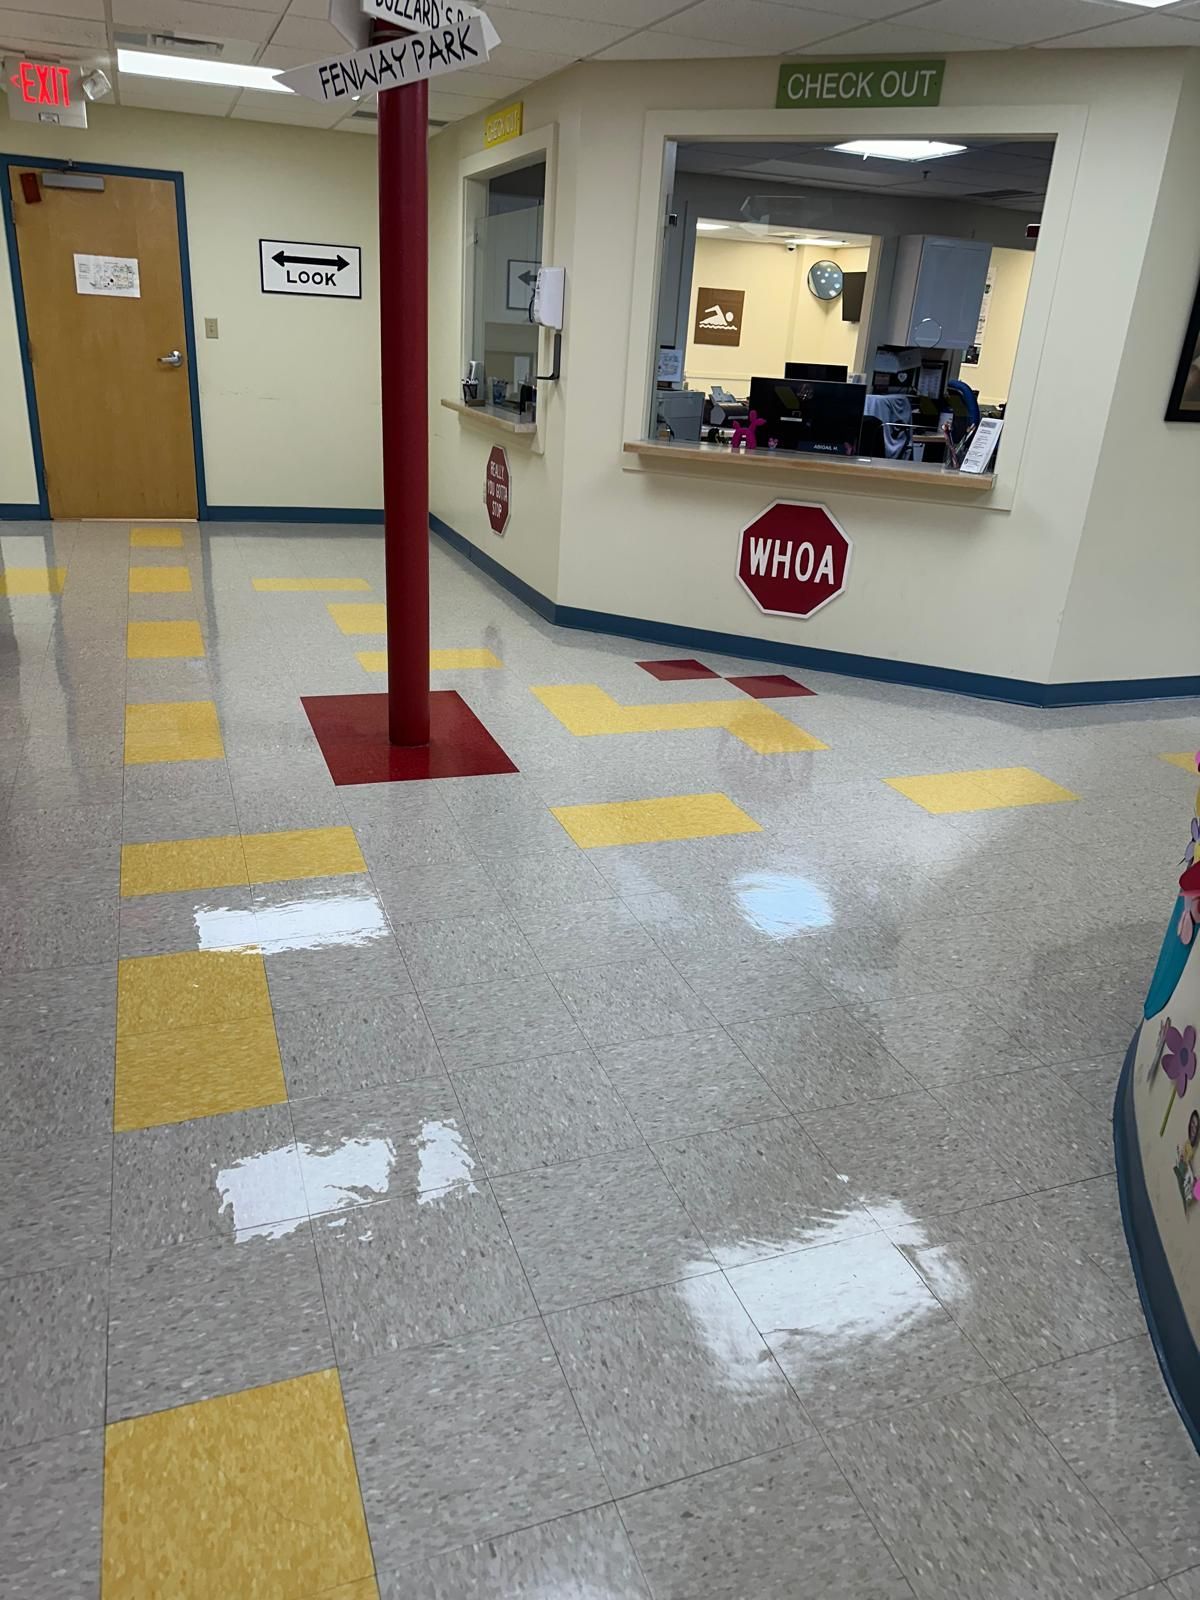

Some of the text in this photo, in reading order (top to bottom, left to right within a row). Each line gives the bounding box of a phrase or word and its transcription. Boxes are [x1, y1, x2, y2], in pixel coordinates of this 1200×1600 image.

[376, 0, 453, 29] ZZARD'S
[319, 24, 478, 99] FENWAY PARK
[20, 62, 70, 107] EXIT
[787, 70, 936, 100] CHECK OUT
[286, 270, 336, 286] LOOK
[487, 480, 508, 503] YOU GOTTA
[492, 500, 502, 519] STOP
[750, 536, 834, 585] WHOA
